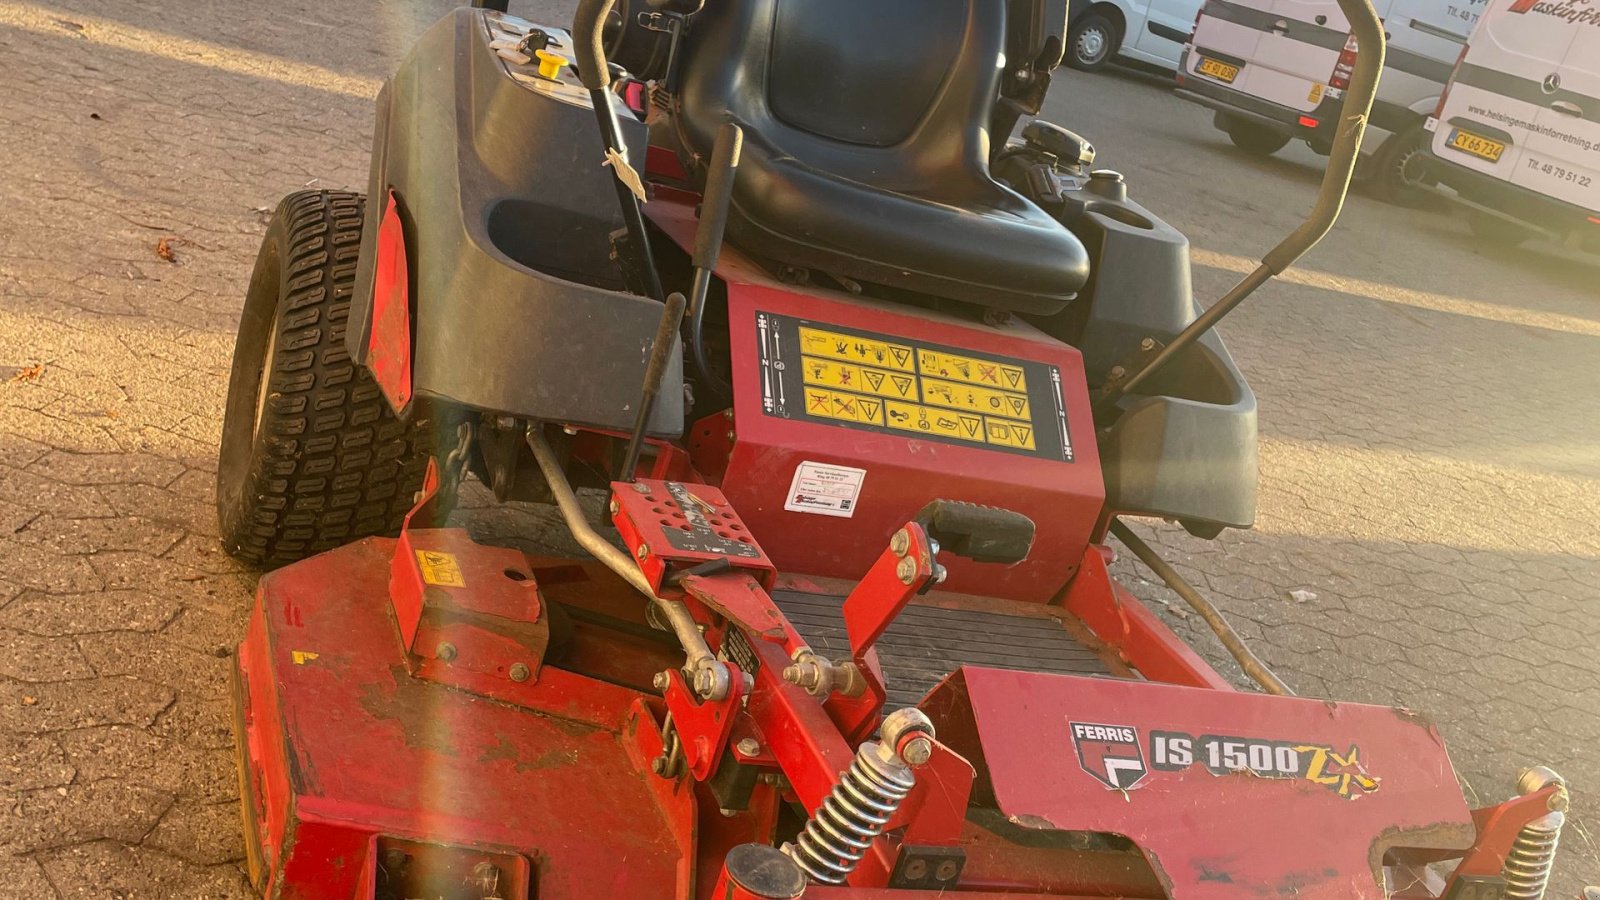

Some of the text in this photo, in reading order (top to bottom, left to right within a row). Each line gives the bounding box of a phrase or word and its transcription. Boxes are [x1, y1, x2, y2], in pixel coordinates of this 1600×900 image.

[1455, 133, 1502, 157] CY 66 734
[1541, 163, 1553, 175] 48
[1553, 167, 1566, 178] 79
[1565, 171, 1577, 182] 51
[1578, 175, 1592, 188] 22
[1074, 724, 1135, 744] FERRIS
[1155, 736, 1194, 766] IS
